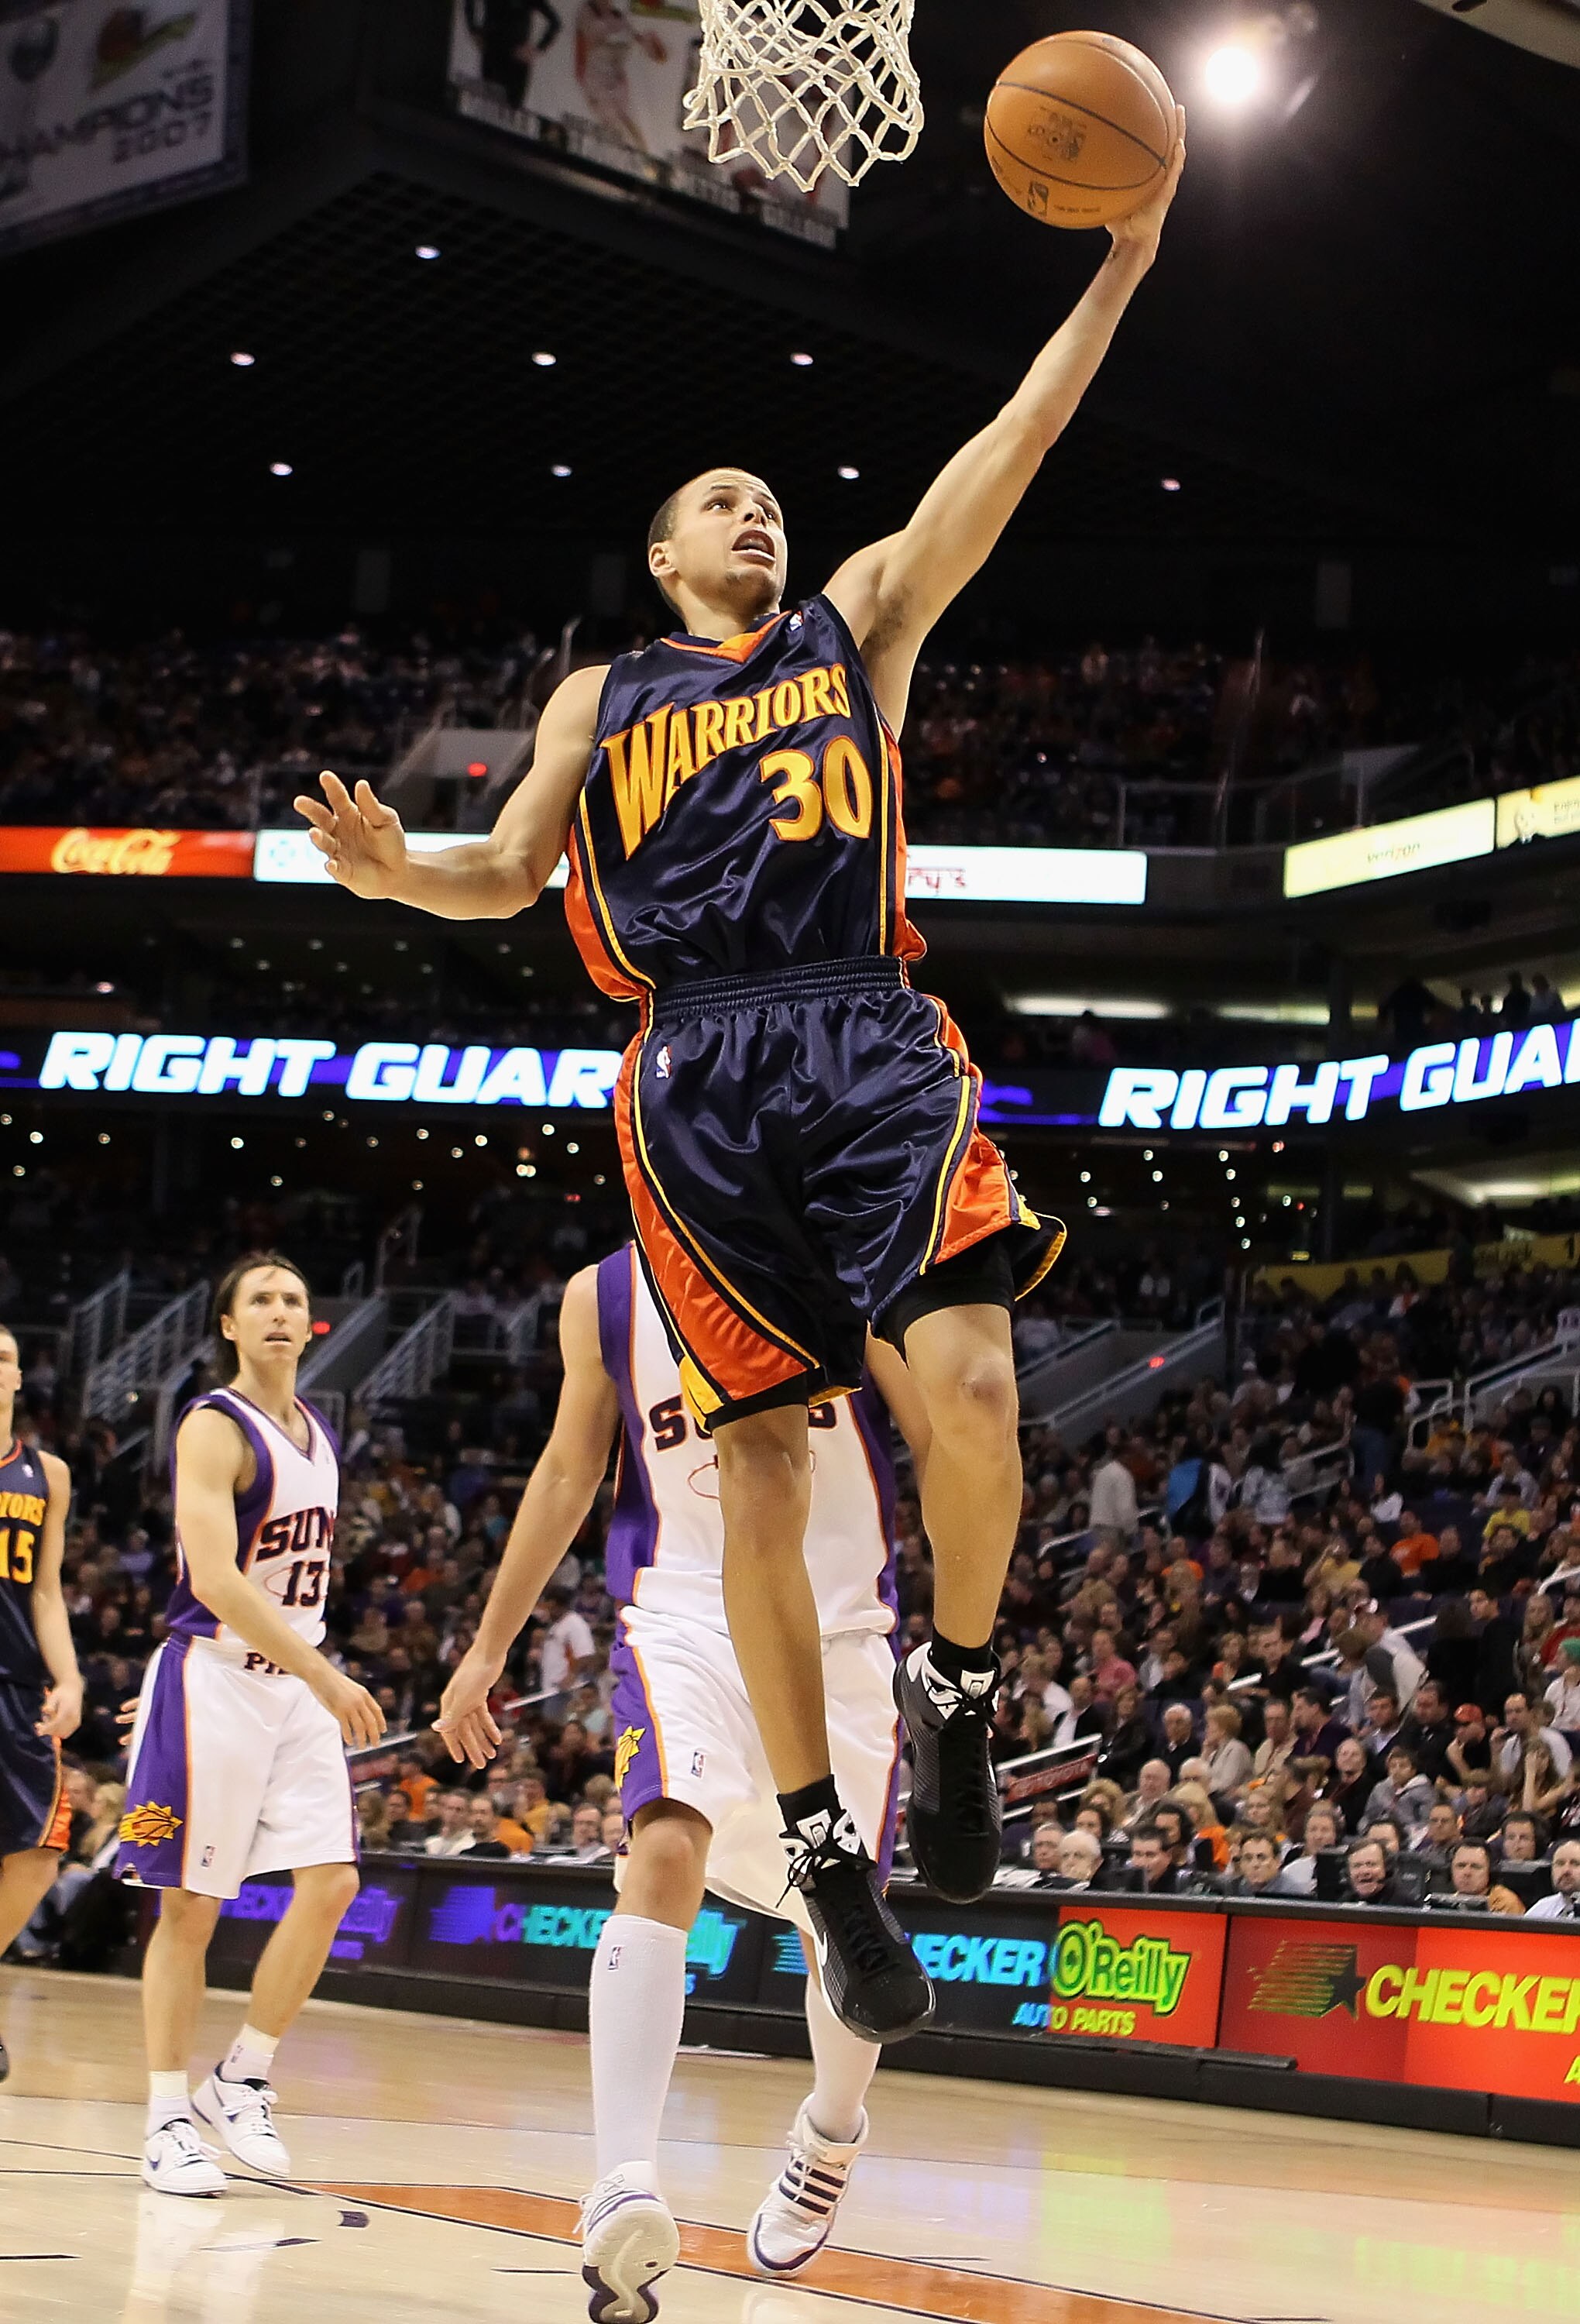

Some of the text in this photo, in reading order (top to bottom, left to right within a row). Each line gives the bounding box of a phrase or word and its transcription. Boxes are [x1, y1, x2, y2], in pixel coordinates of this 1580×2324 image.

[113, 112, 212, 164] 2007
[600, 662, 851, 861] WARRIORS
[759, 734, 874, 841] 30
[1367, 841, 1421, 864] verizon
[39, 1031, 617, 1108] RIGHT GUAR
[1097, 1053, 1389, 1129] RIGHT
[0, 1490, 46, 1526] IORS
[282, 1560, 324, 1607] 13
[1053, 1917, 1191, 2016] O'Reilly
[1012, 2001, 1136, 2037] AUTO PARTS
